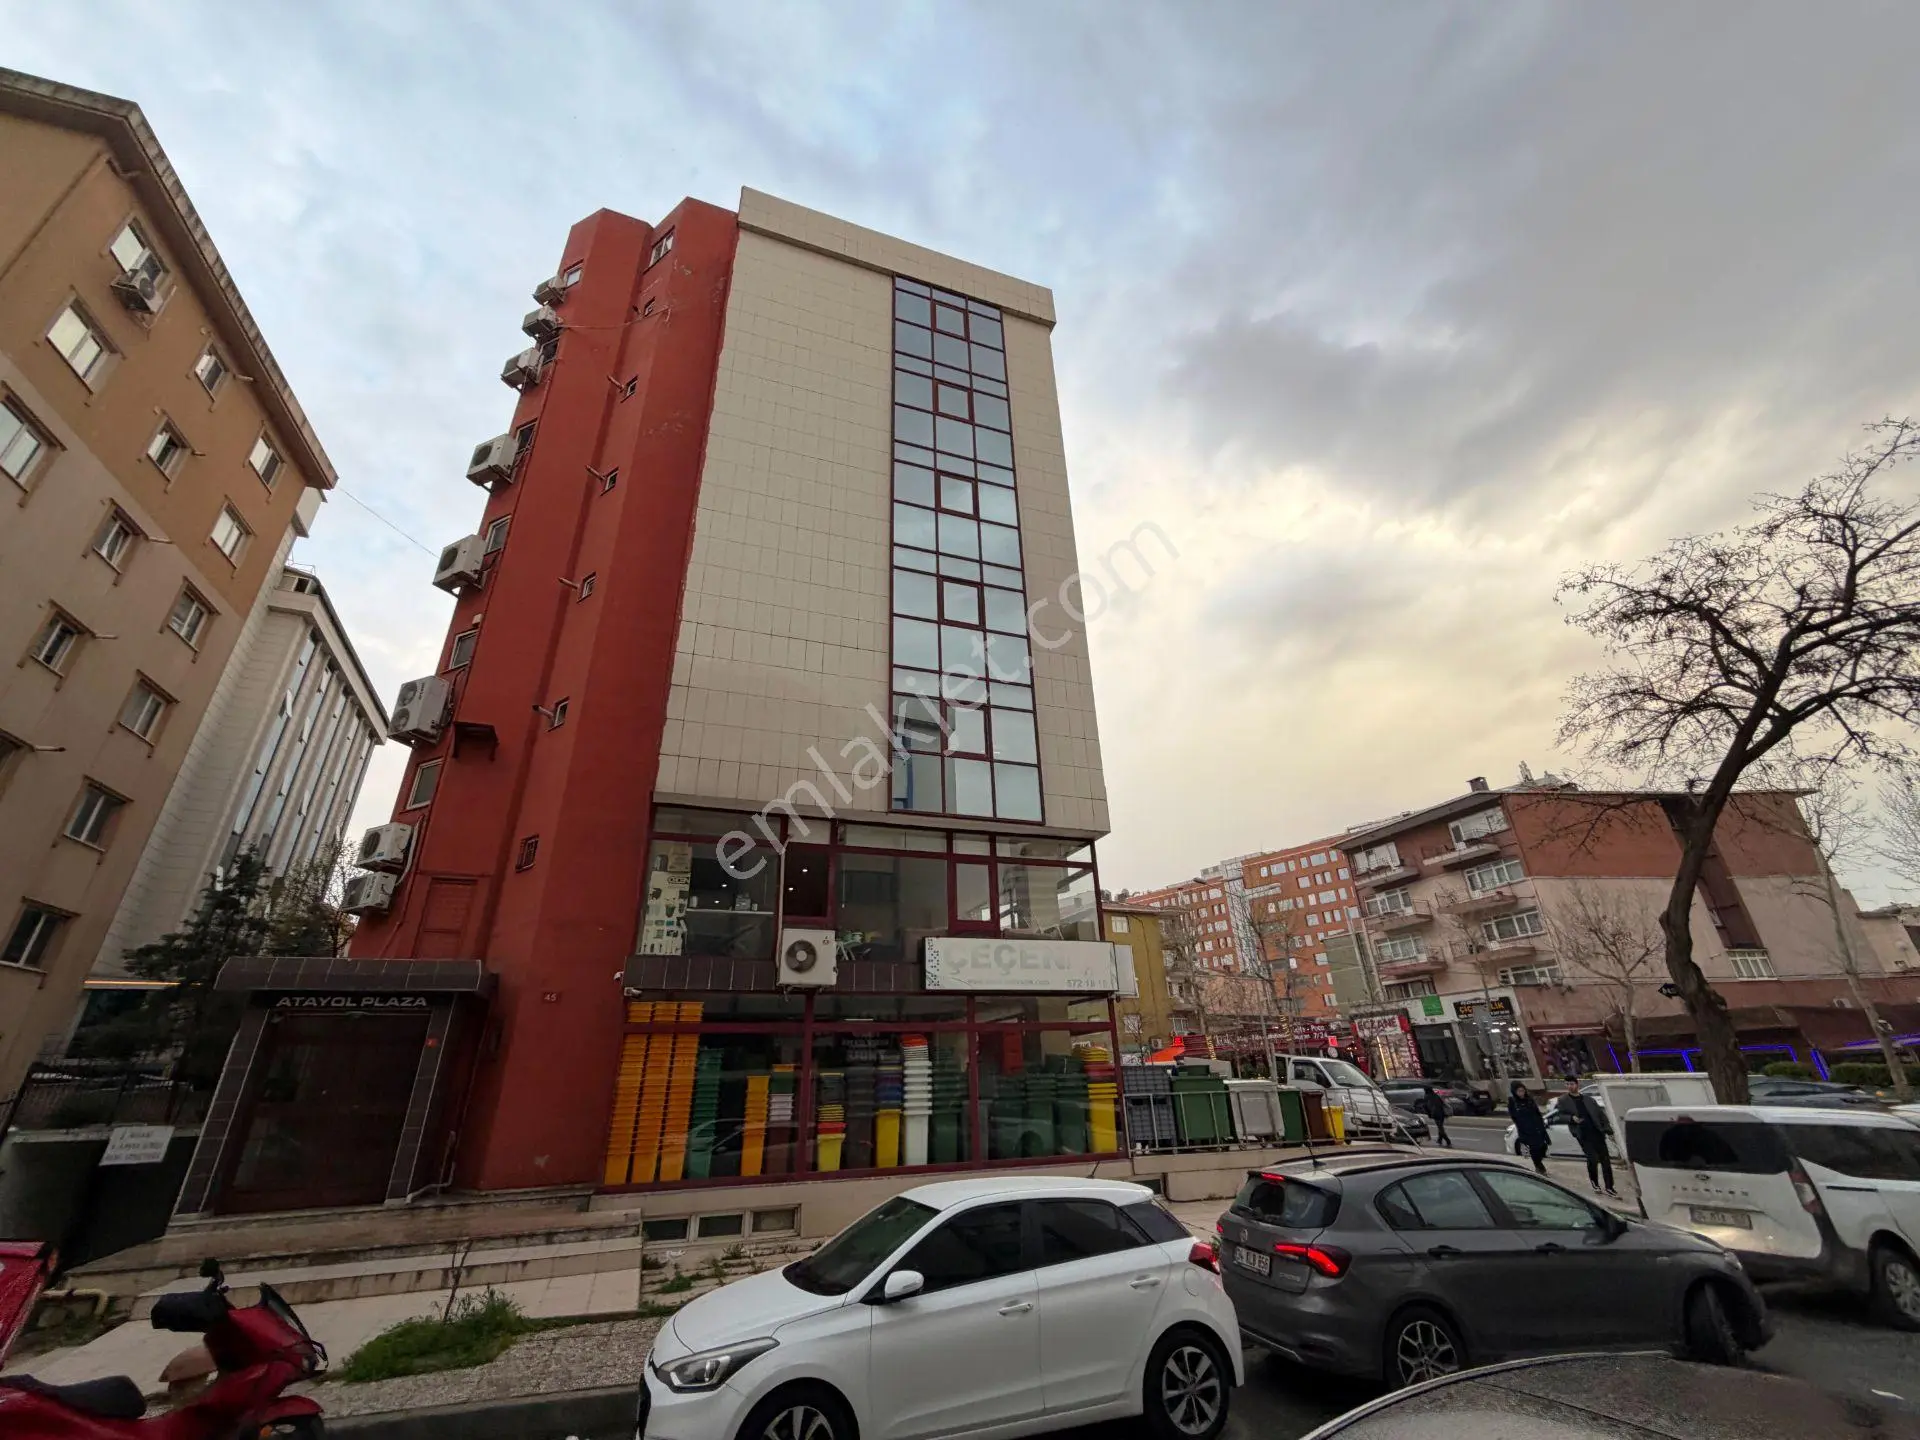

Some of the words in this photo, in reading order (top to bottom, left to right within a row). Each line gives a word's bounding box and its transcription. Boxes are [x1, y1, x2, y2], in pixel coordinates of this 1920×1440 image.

[276, 996, 357, 1007] ATAYOL
[360, 996, 427, 1007] PLAZA
[544, 993, 557, 1002] 45
[1358, 1017, 1398, 1031] ECZANE
[1406, 1033, 1422, 1077] ECZANE
